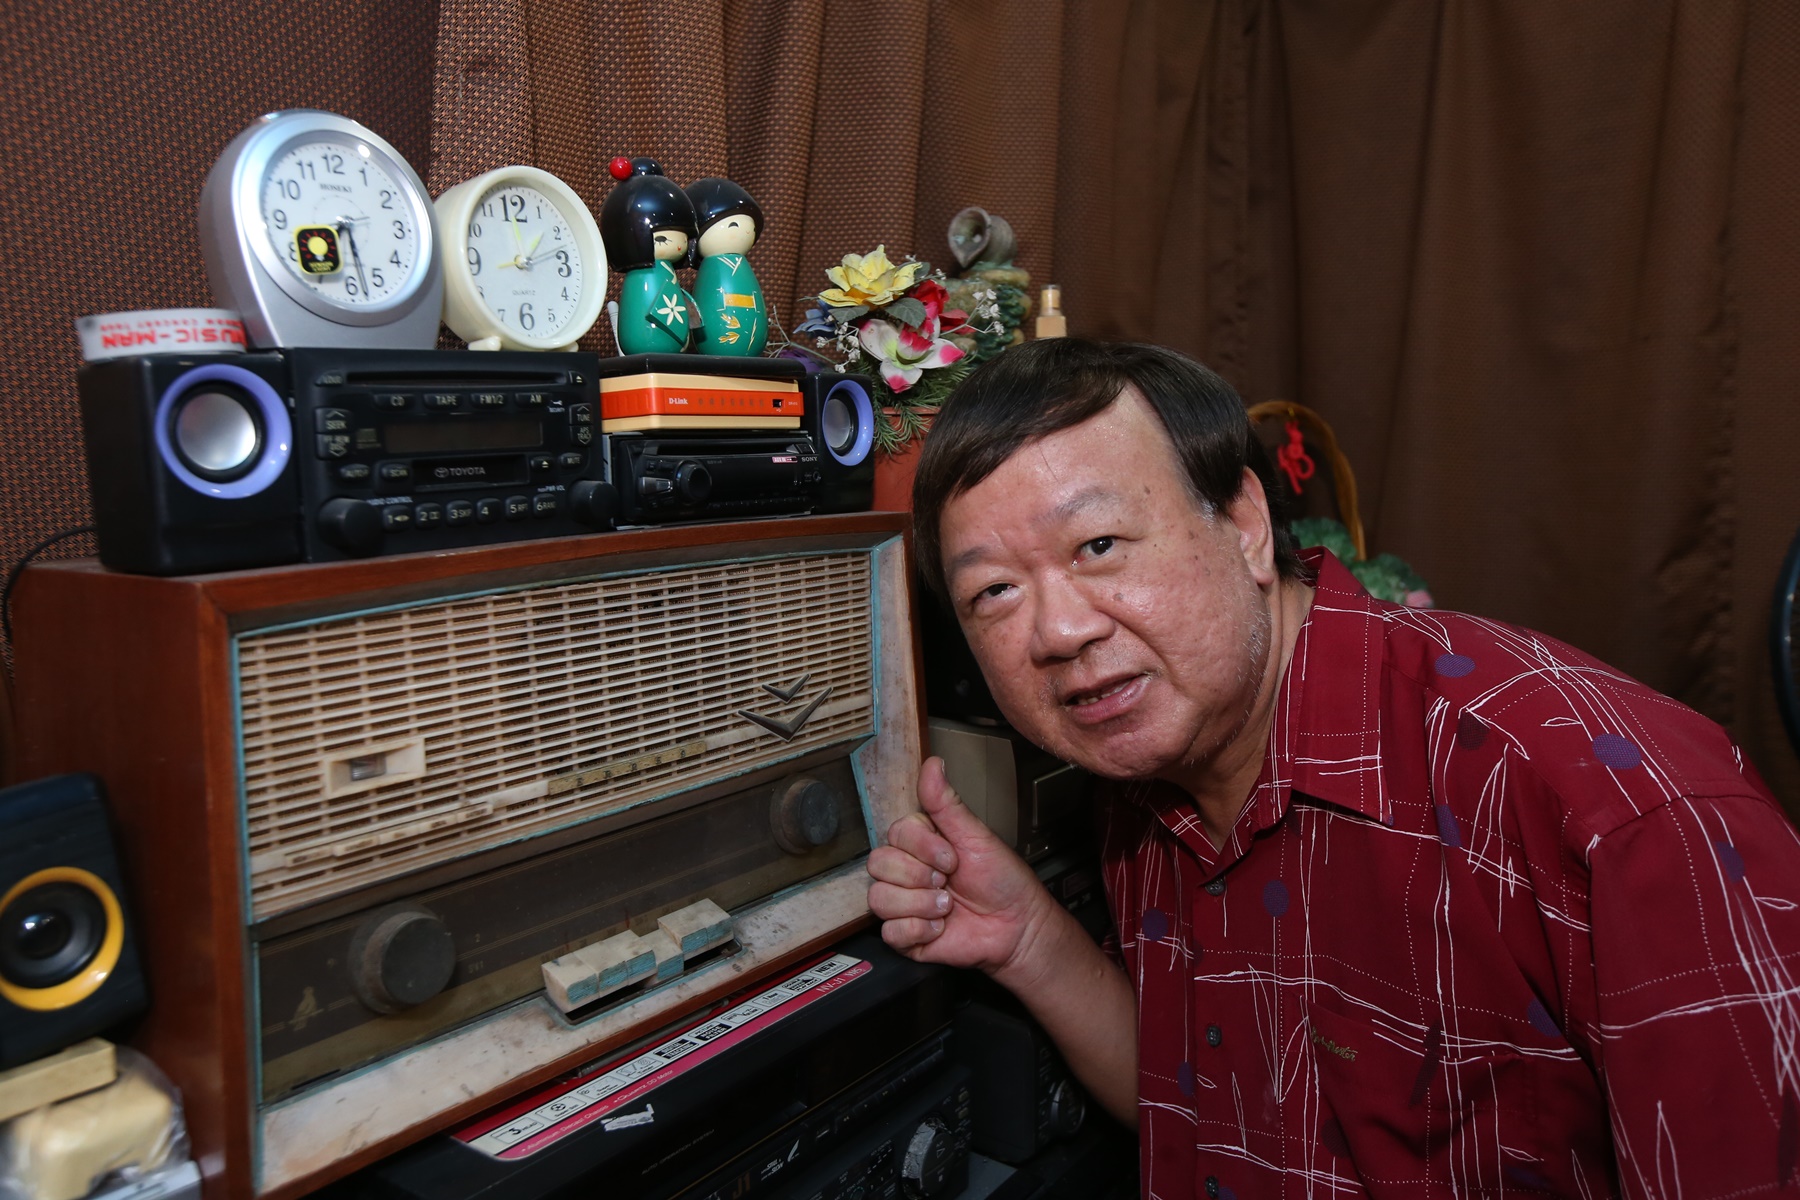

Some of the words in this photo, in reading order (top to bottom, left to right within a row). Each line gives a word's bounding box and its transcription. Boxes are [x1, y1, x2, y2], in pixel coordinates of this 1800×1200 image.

[296, 159, 316, 180] 11
[321, 153, 345, 175] 12
[359, 166, 368, 187] 1
[277, 179, 301, 201] 10
[380, 190, 393, 210] 2
[482, 203, 494, 218] 11
[499, 194, 528, 223] 12
[536, 205, 542, 220] 1
[273, 209, 288, 231] 9
[393, 220, 406, 240] 3
[552, 225, 561, 241] 2
[389, 249, 402, 268] 4
[468, 247, 482, 276] 9
[555, 250, 572, 278] 3
[372, 268, 385, 288] 5
[345, 276, 359, 296] 6
[561, 286, 569, 301] 4
[497, 308, 506, 323] 7
[519, 302, 535, 331] 6
[548, 308, 556, 323] 5
[390, 395, 405, 407] CD
[435, 394, 457, 406] TAPE
[530, 394, 542, 404] AM
[668, 397, 689, 405] D-Link
[325, 420, 347, 430] SEEK
[577, 413, 590, 422] TUNE
[567, 456, 581, 465] MUTE
[449, 466, 486, 476] TOYOTA
[481, 506, 489, 516] 4
[510, 504, 518, 514] 5
[536, 501, 544, 511] 6
[387, 514, 393, 524] 1
[419, 511, 428, 521] 2
[451, 509, 459, 519] 3
[815, 961, 837, 973] NEW
[584, 1105, 609, 1119] Chassis
[656, 1070, 674, 1081] Motor
[508, 1127, 521, 1136] 3
